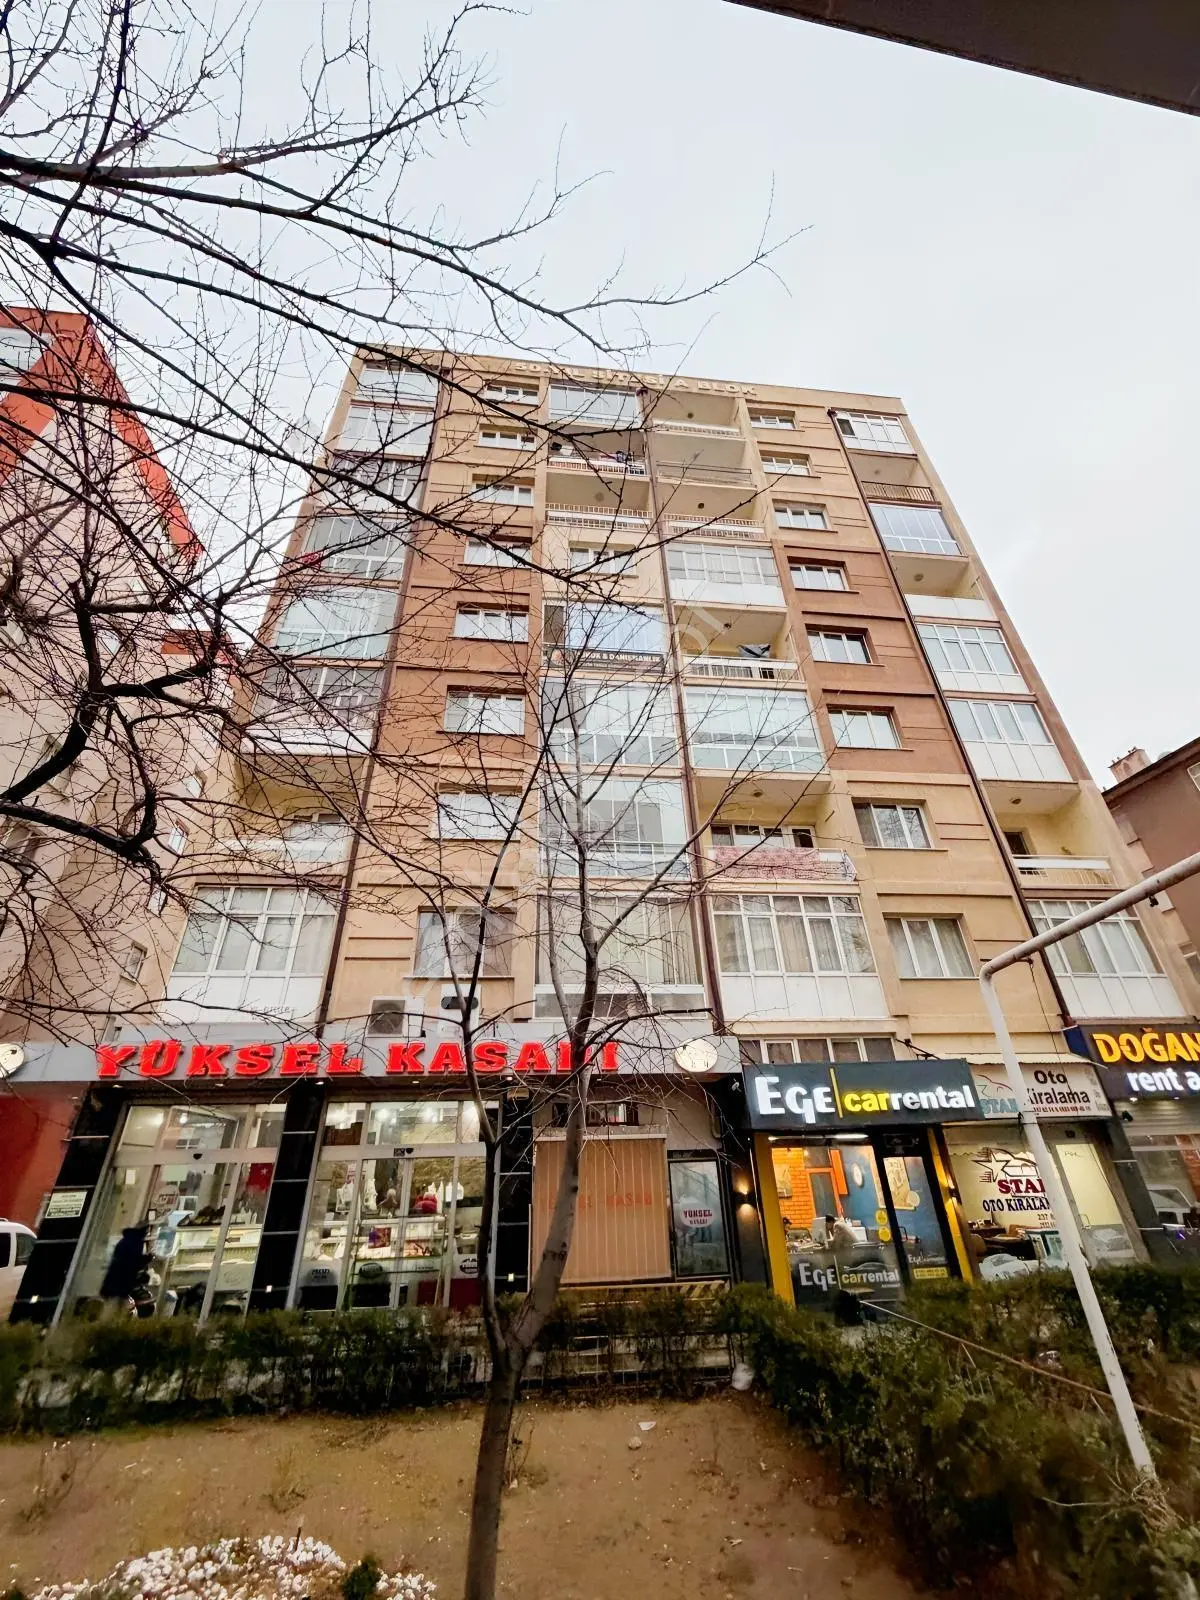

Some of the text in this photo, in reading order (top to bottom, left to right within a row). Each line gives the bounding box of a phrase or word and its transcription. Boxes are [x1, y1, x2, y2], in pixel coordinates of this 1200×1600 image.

[674, 379, 690, 389] A
[697, 381, 758, 396] BLOK
[1092, 1027, 1200, 1063] DOĞAN
[96, 1039, 363, 1078] YÜKSEL
[1033, 1069, 1068, 1085] Oto
[1126, 1067, 1184, 1092] rent
[982, 1199, 1005, 1213] OTO
